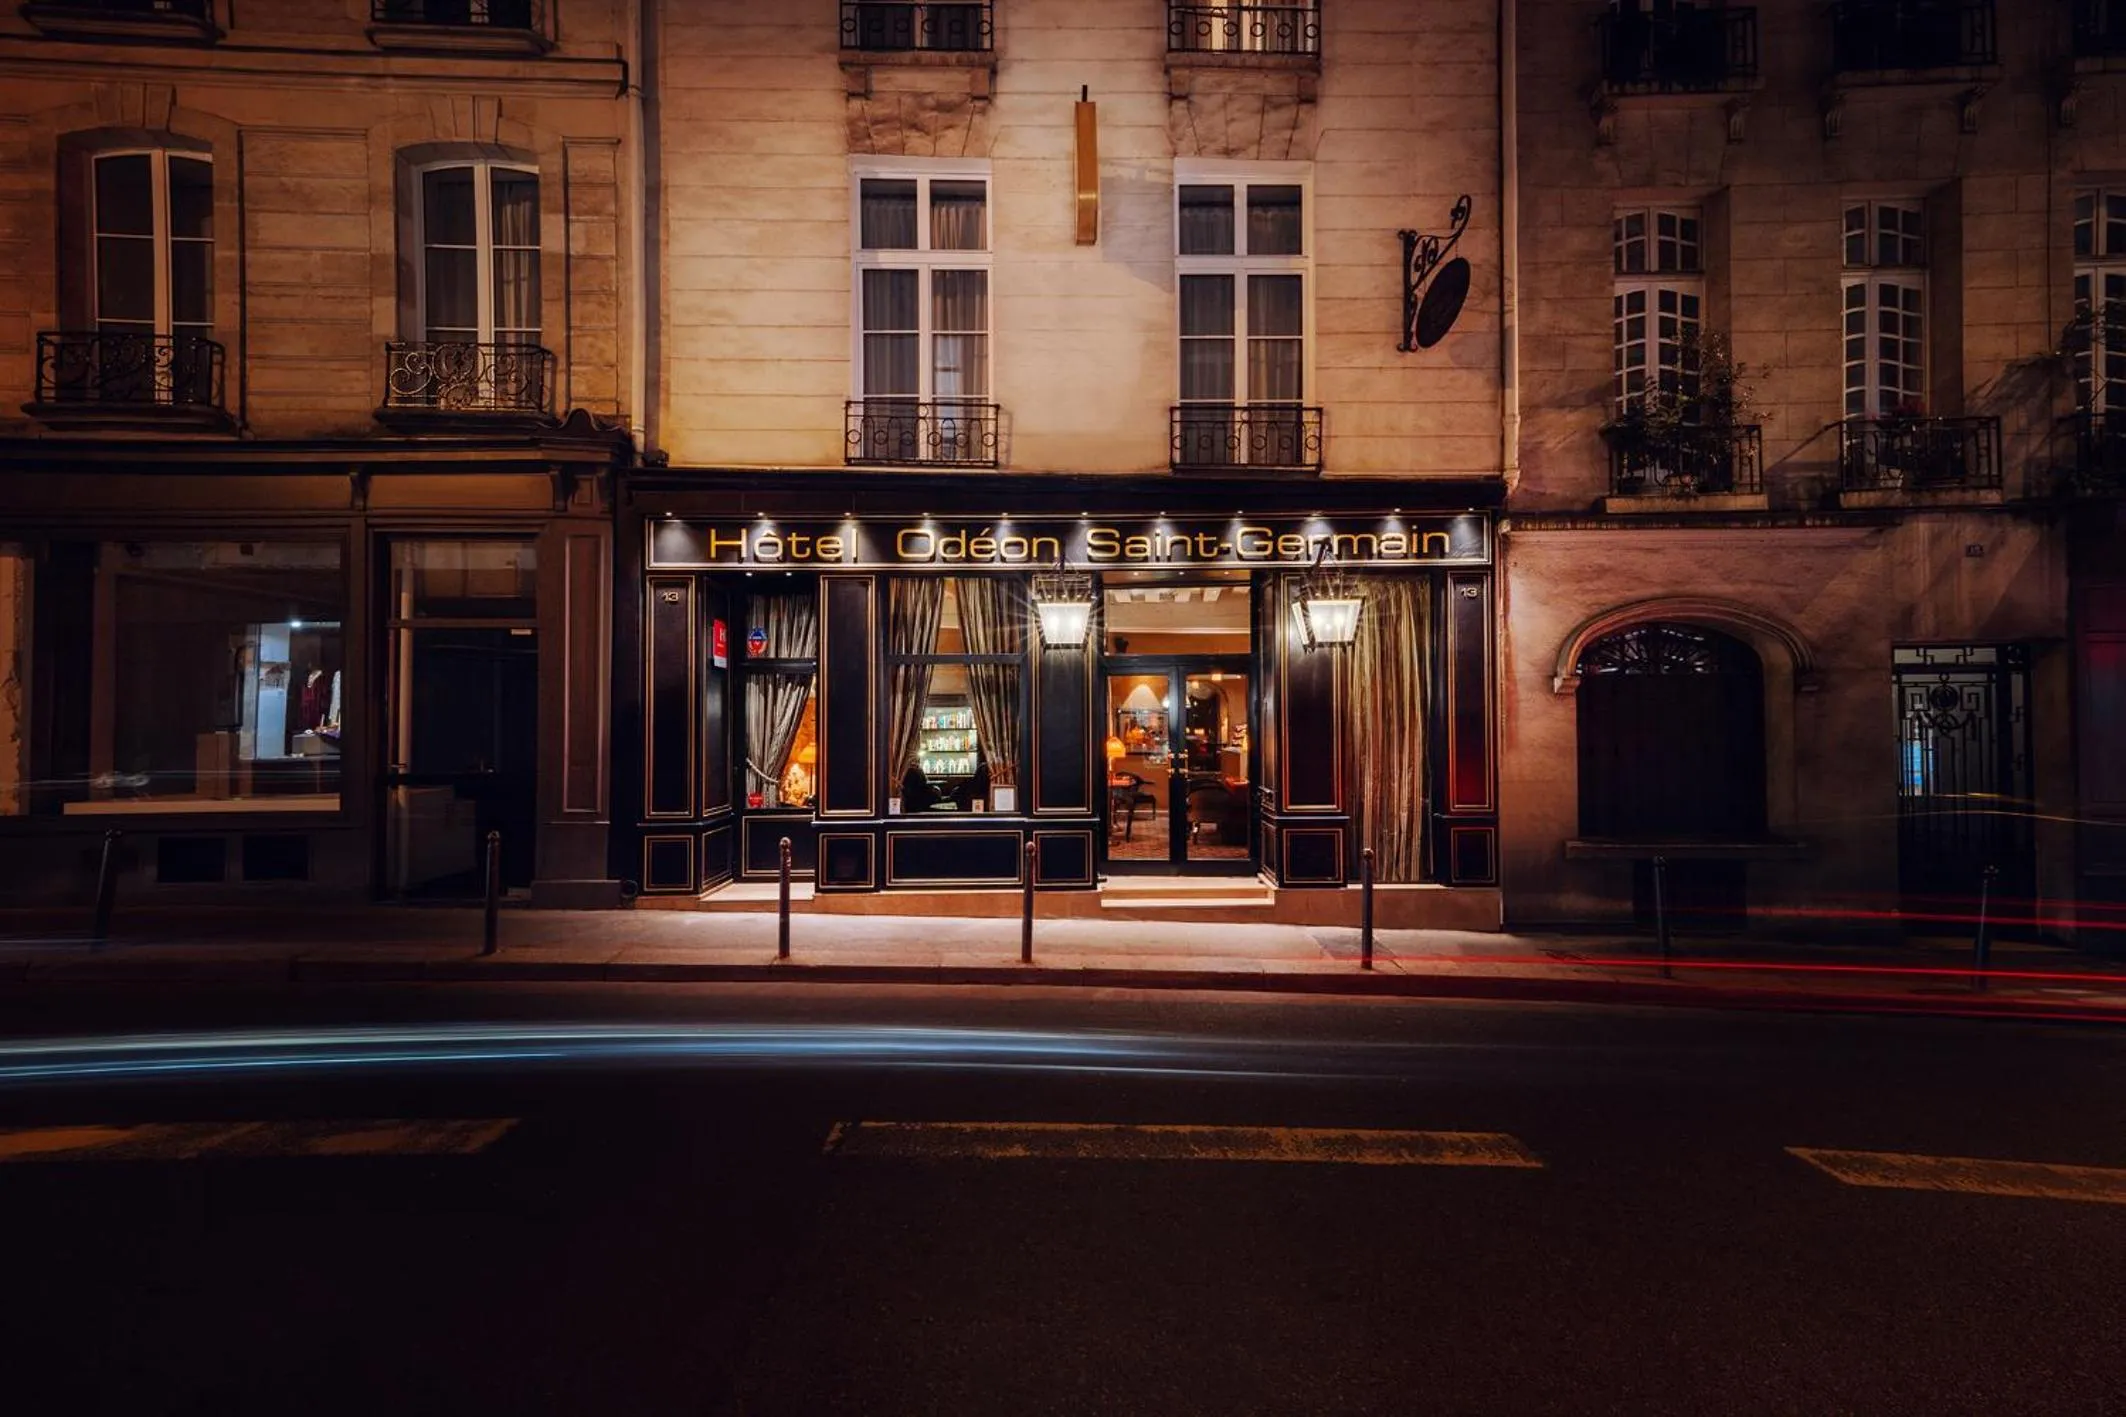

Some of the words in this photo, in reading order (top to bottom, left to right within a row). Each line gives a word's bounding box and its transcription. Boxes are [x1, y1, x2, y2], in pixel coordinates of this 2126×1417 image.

[710, 528, 857, 558] Hôtel
[896, 528, 1059, 559] Odéon
[1087, 525, 1451, 558] Saint-Germain
[662, 591, 679, 602] 13
[1460, 587, 1478, 598] 13
